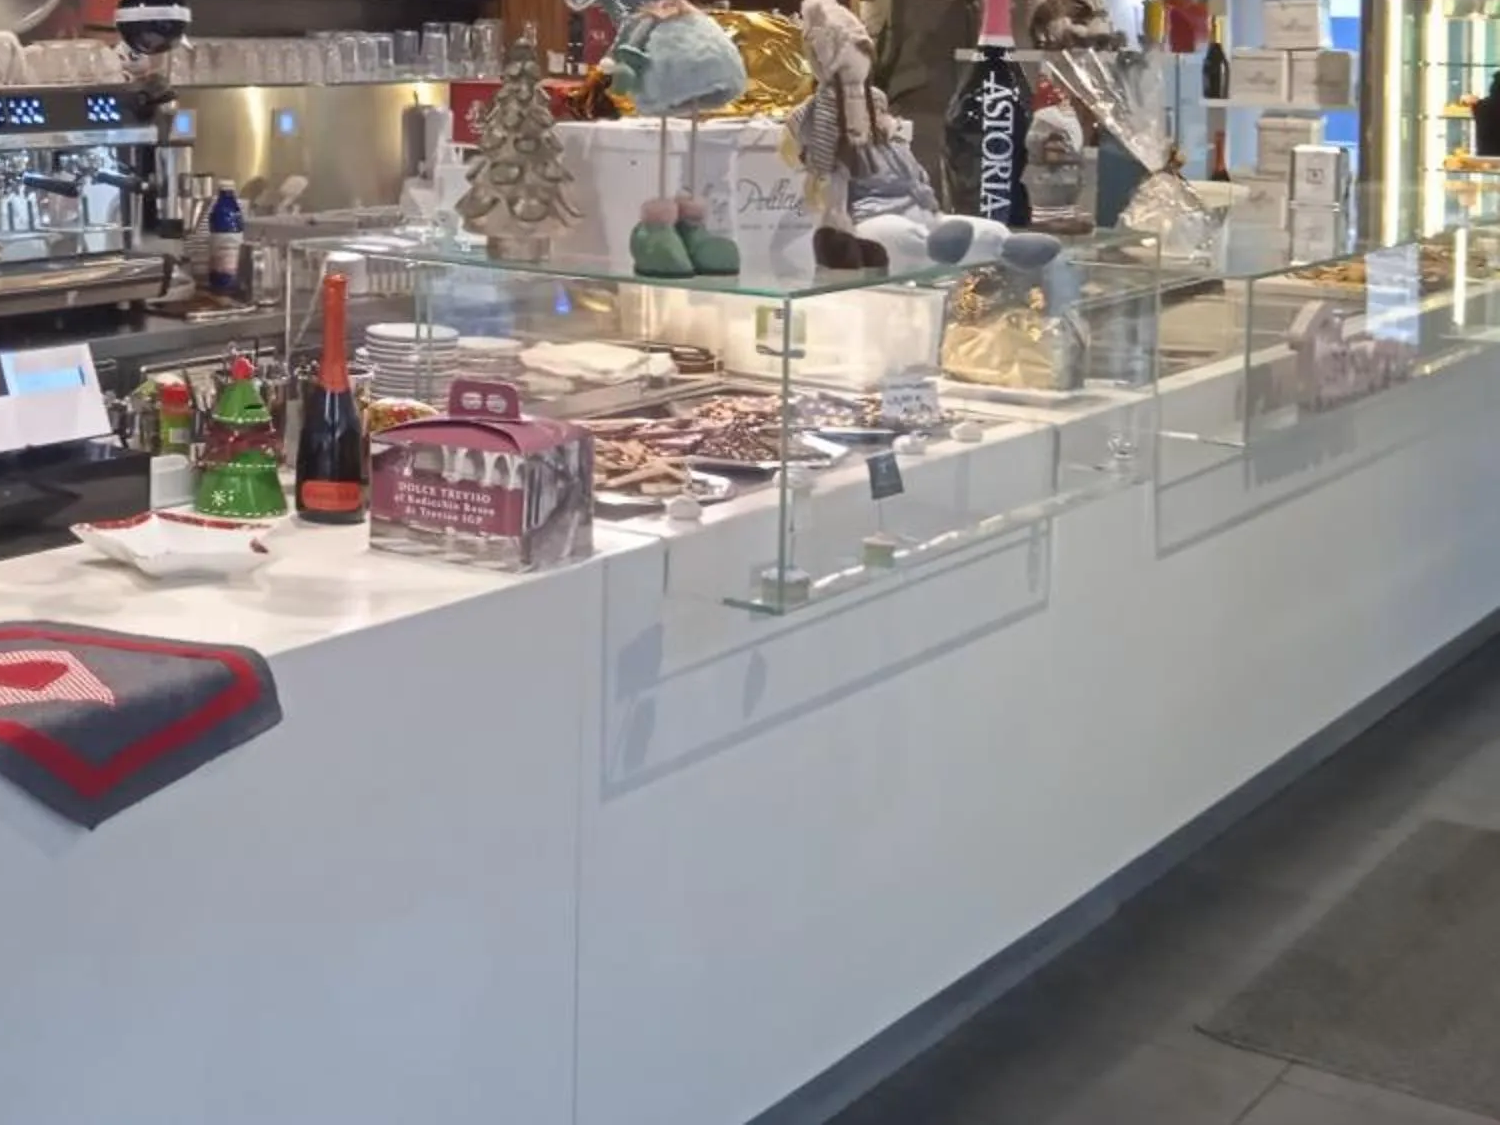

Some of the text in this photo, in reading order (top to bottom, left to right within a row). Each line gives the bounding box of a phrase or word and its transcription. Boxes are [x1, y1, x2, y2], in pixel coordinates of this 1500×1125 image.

[980, 71, 1015, 220] ASTORIA
[398, 481, 492, 504] DOLCE TREVISO
